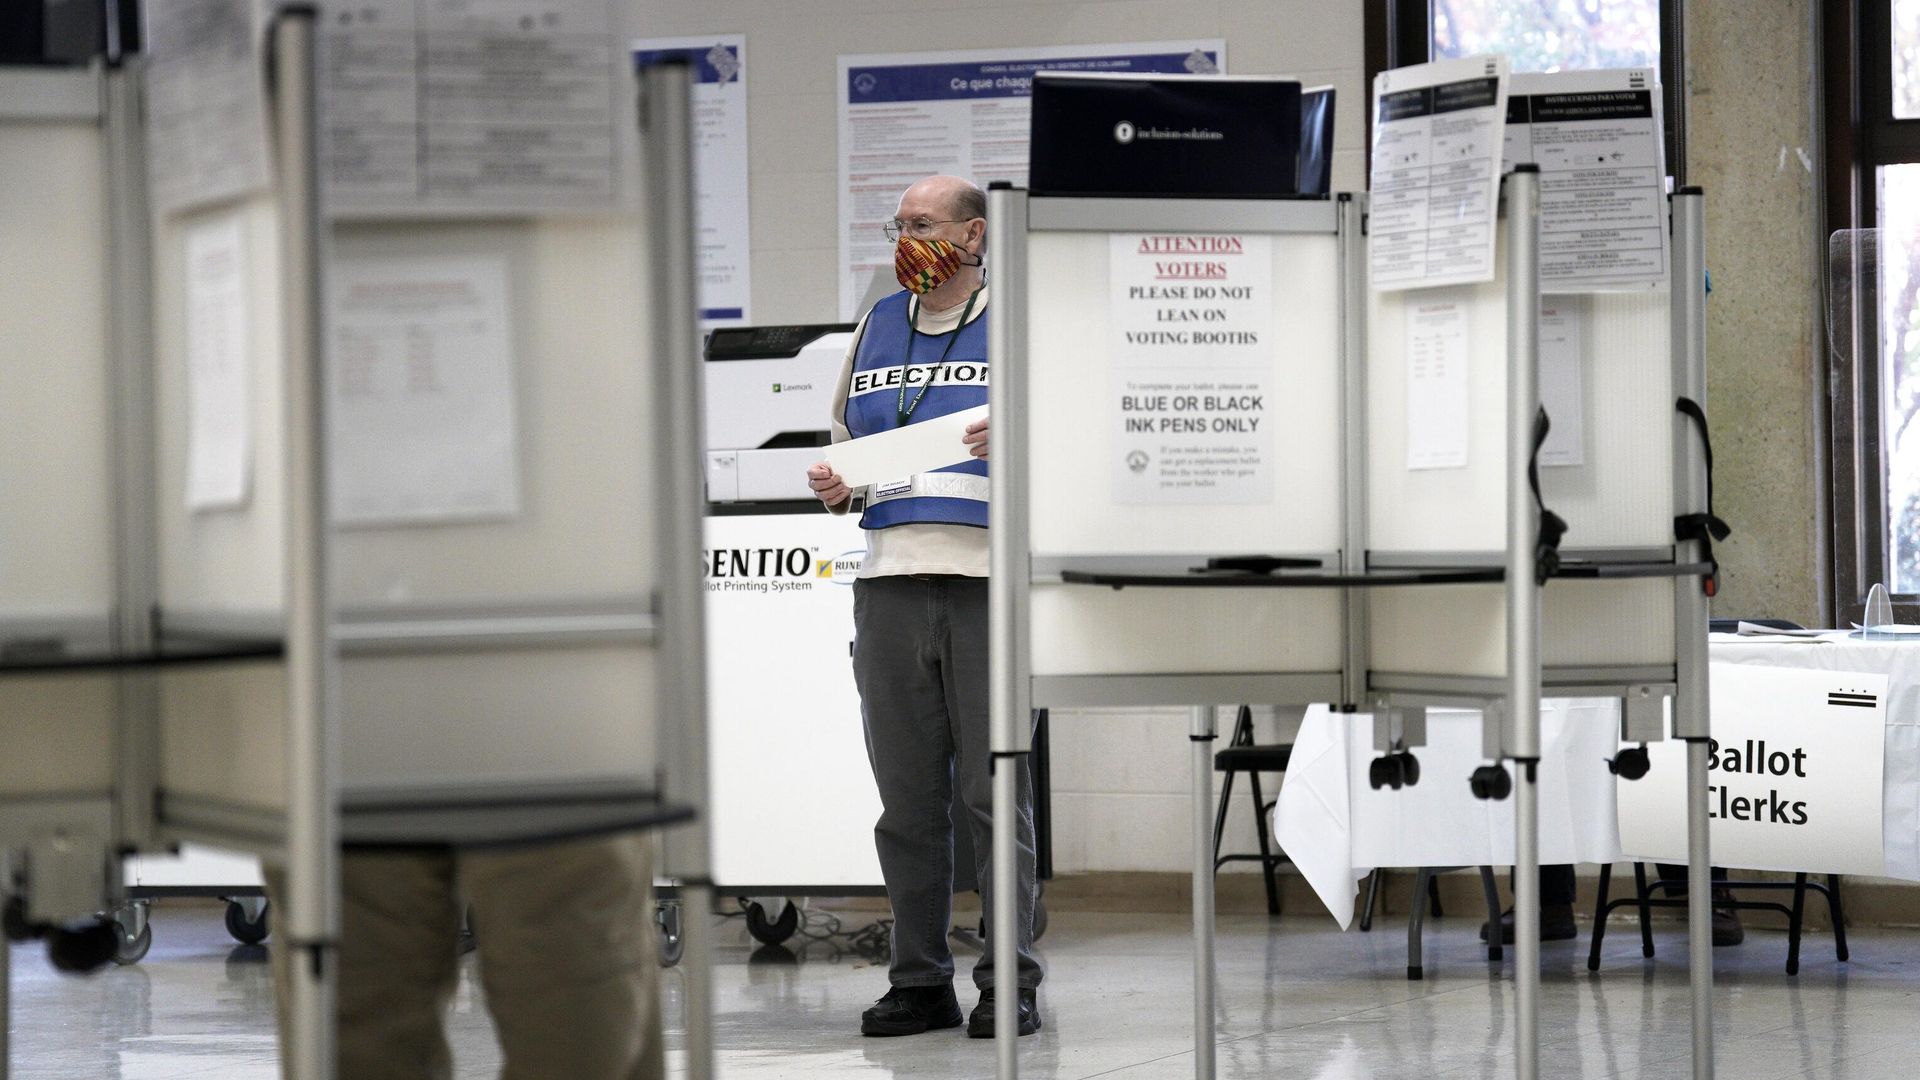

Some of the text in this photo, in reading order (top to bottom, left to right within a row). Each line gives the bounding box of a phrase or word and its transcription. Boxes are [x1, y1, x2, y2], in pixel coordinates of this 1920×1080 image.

[951, 75, 1032, 92] Ce que chaqu
[1138, 236, 1243, 252] ATTENTION
[1155, 261, 1228, 277] VOTERS
[1129, 286, 1253, 299] PLEASE DO NOT
[1157, 309, 1227, 322] LEAN ON
[1126, 331, 1258, 345] VOTING BOOTHS
[783, 383, 812, 391] Lexmark
[1122, 395, 1263, 411] BLUE OR BLACK
[1126, 417, 1260, 433] INK PENS ONLY
[1240, 456, 1260, 465] ballot
[704, 581, 812, 593] llot Printing System
